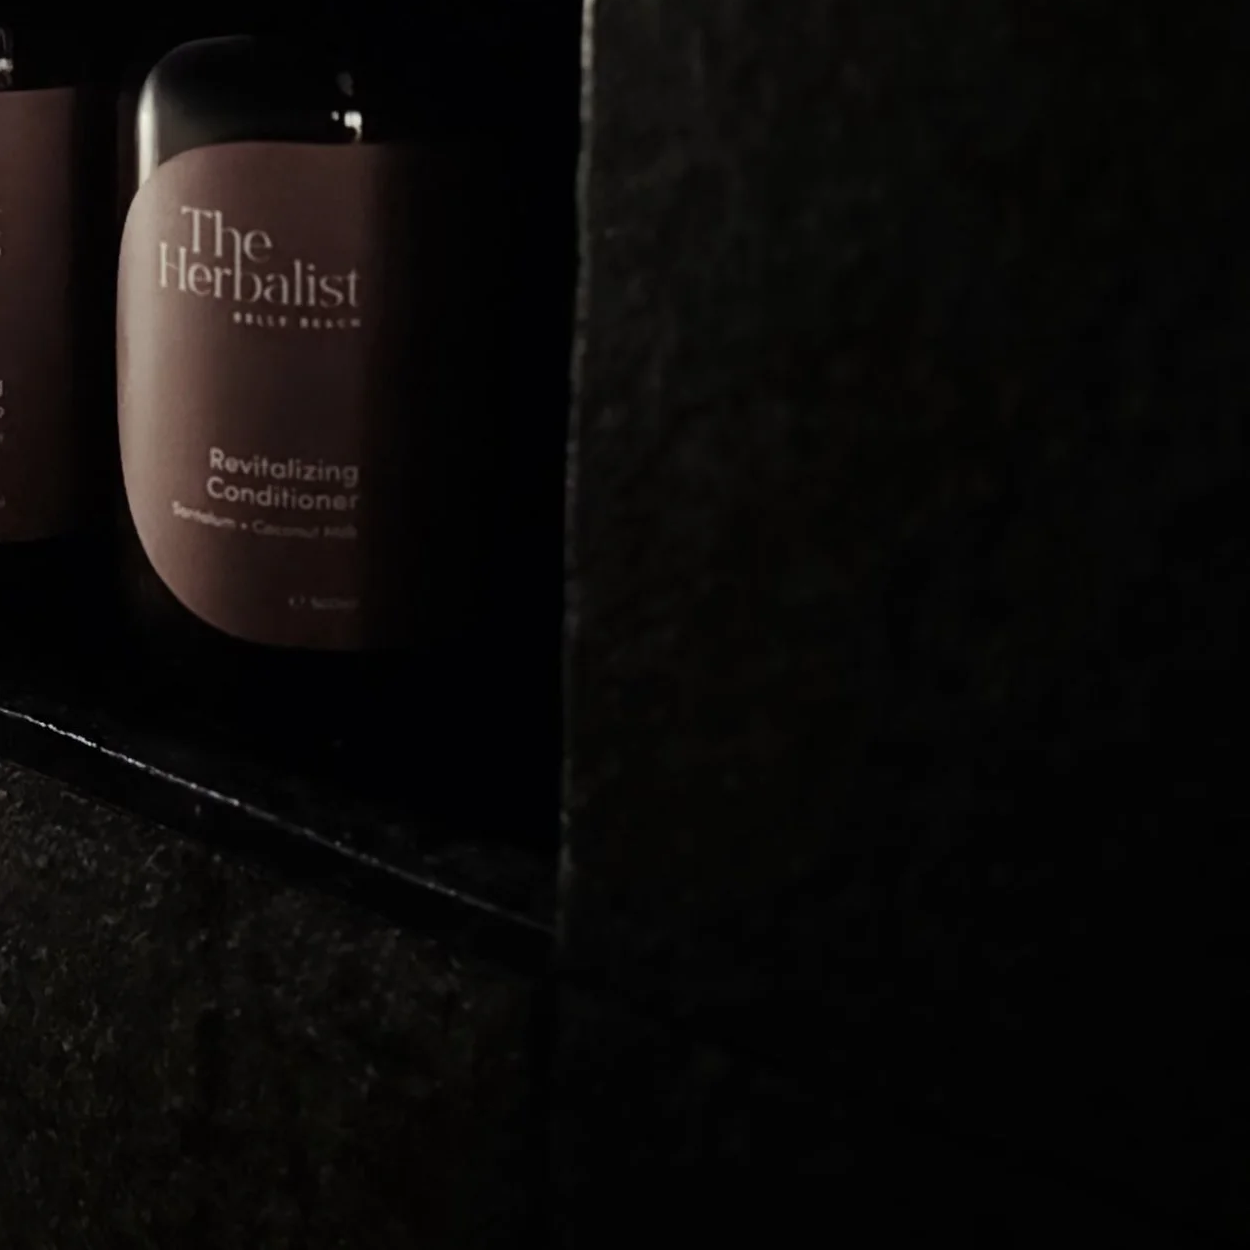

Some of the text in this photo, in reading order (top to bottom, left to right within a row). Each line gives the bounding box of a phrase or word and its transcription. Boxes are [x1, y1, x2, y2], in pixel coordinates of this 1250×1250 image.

[180, 205, 274, 263] The
[160, 241, 360, 308] Herbalist
[209, 446, 359, 488] Revitalizing
[206, 476, 361, 511] Conditioner
